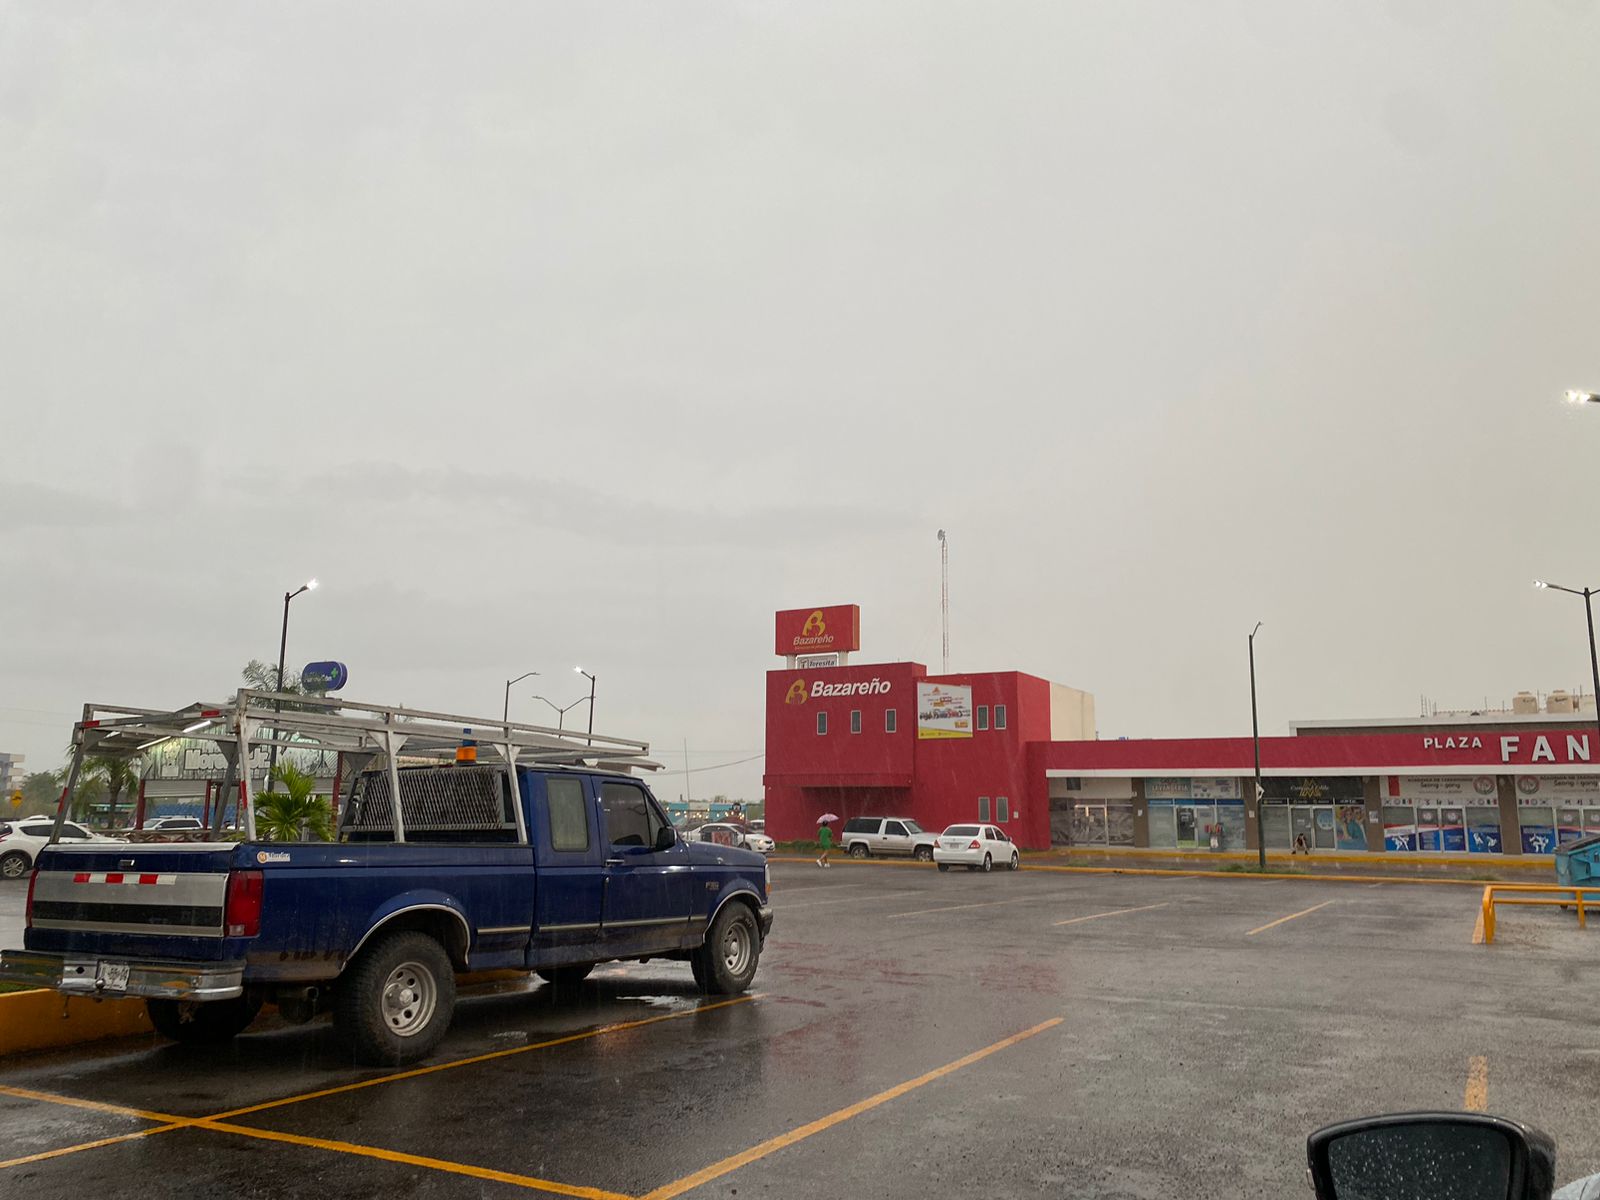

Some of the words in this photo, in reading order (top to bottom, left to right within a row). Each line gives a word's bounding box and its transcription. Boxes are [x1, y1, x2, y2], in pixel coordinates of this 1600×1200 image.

[793, 634, 834, 646] Bazareño
[811, 677, 891, 697] Bazareño
[1424, 737, 1482, 749] PLAZA
[1500, 735, 1590, 762] FAN
